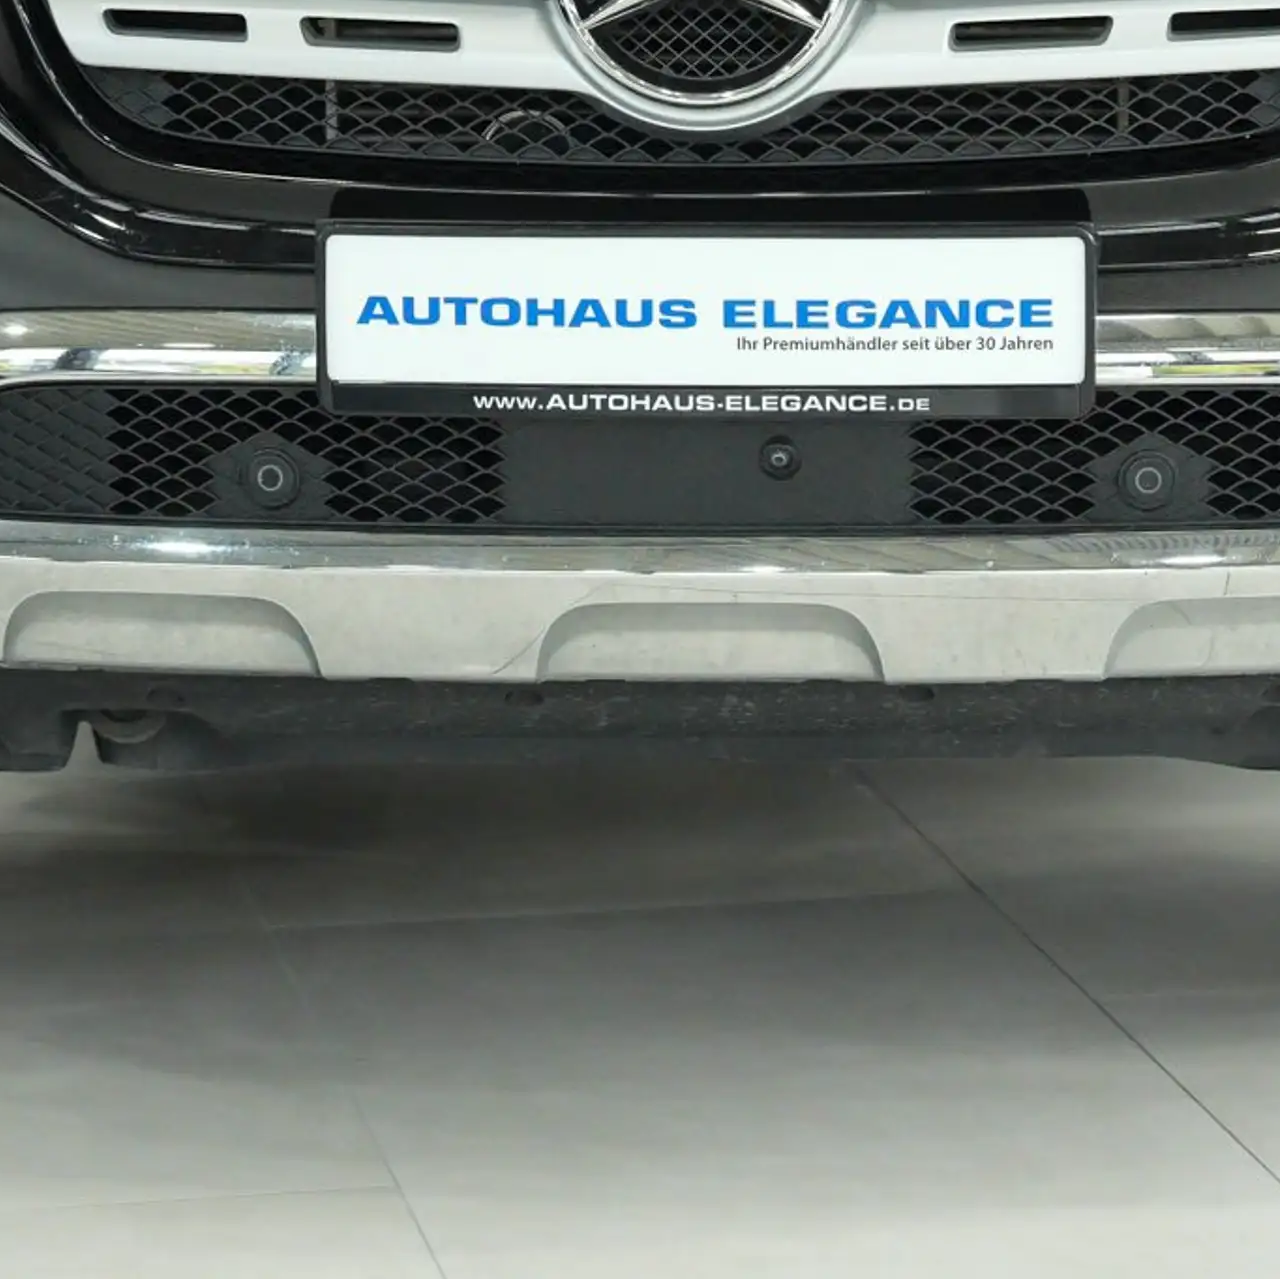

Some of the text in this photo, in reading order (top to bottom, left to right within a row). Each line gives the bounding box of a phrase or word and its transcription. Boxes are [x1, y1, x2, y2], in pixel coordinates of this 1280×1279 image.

[356, 295, 1053, 330] AUTOHAUS ELEGANCE
[737, 335, 1054, 351] Ihr Premiumhändler seit über 30 Jahren
